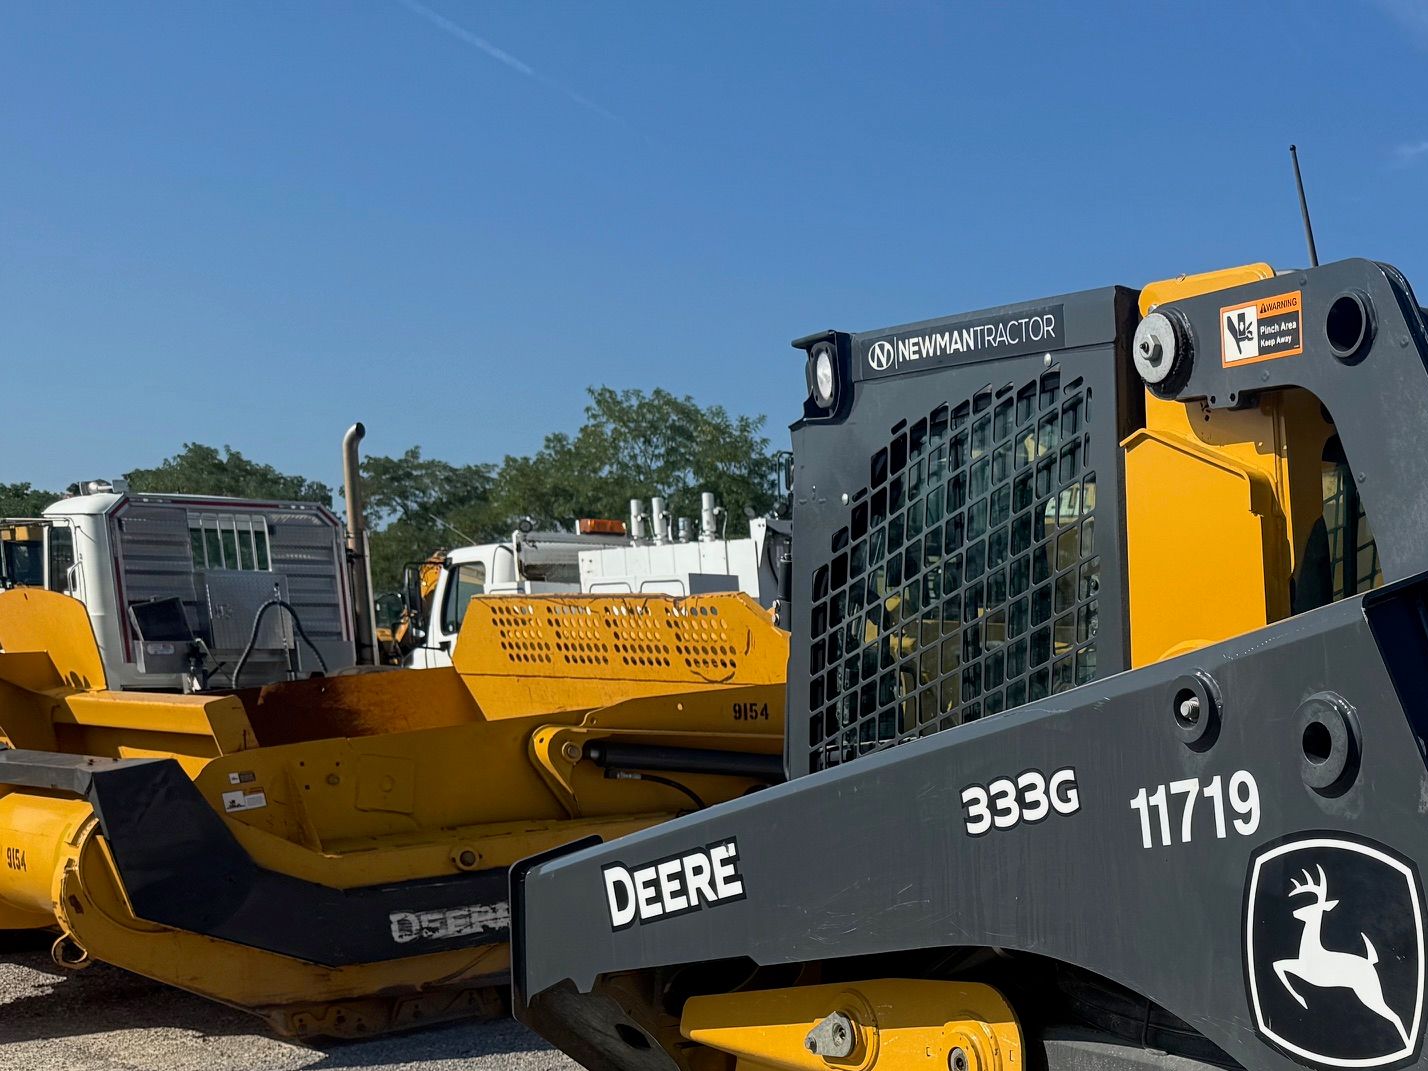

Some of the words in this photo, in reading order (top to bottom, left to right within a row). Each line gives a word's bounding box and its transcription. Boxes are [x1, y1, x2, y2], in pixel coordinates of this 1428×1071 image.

[1266, 298, 1298, 312] WARNING
[898, 315, 1056, 363] NEWMANTRACTOR
[1260, 323, 1279, 335] Pinch
[1280, 321, 1297, 331] Area
[1260, 338, 1276, 347] Keep
[1276, 335, 1292, 345] Away
[733, 703, 768, 720] 9154
[961, 768, 1080, 836] 333G
[1130, 769, 1261, 849] 11719
[7, 847, 27, 872] 9154
[603, 842, 743, 927] DEERE
